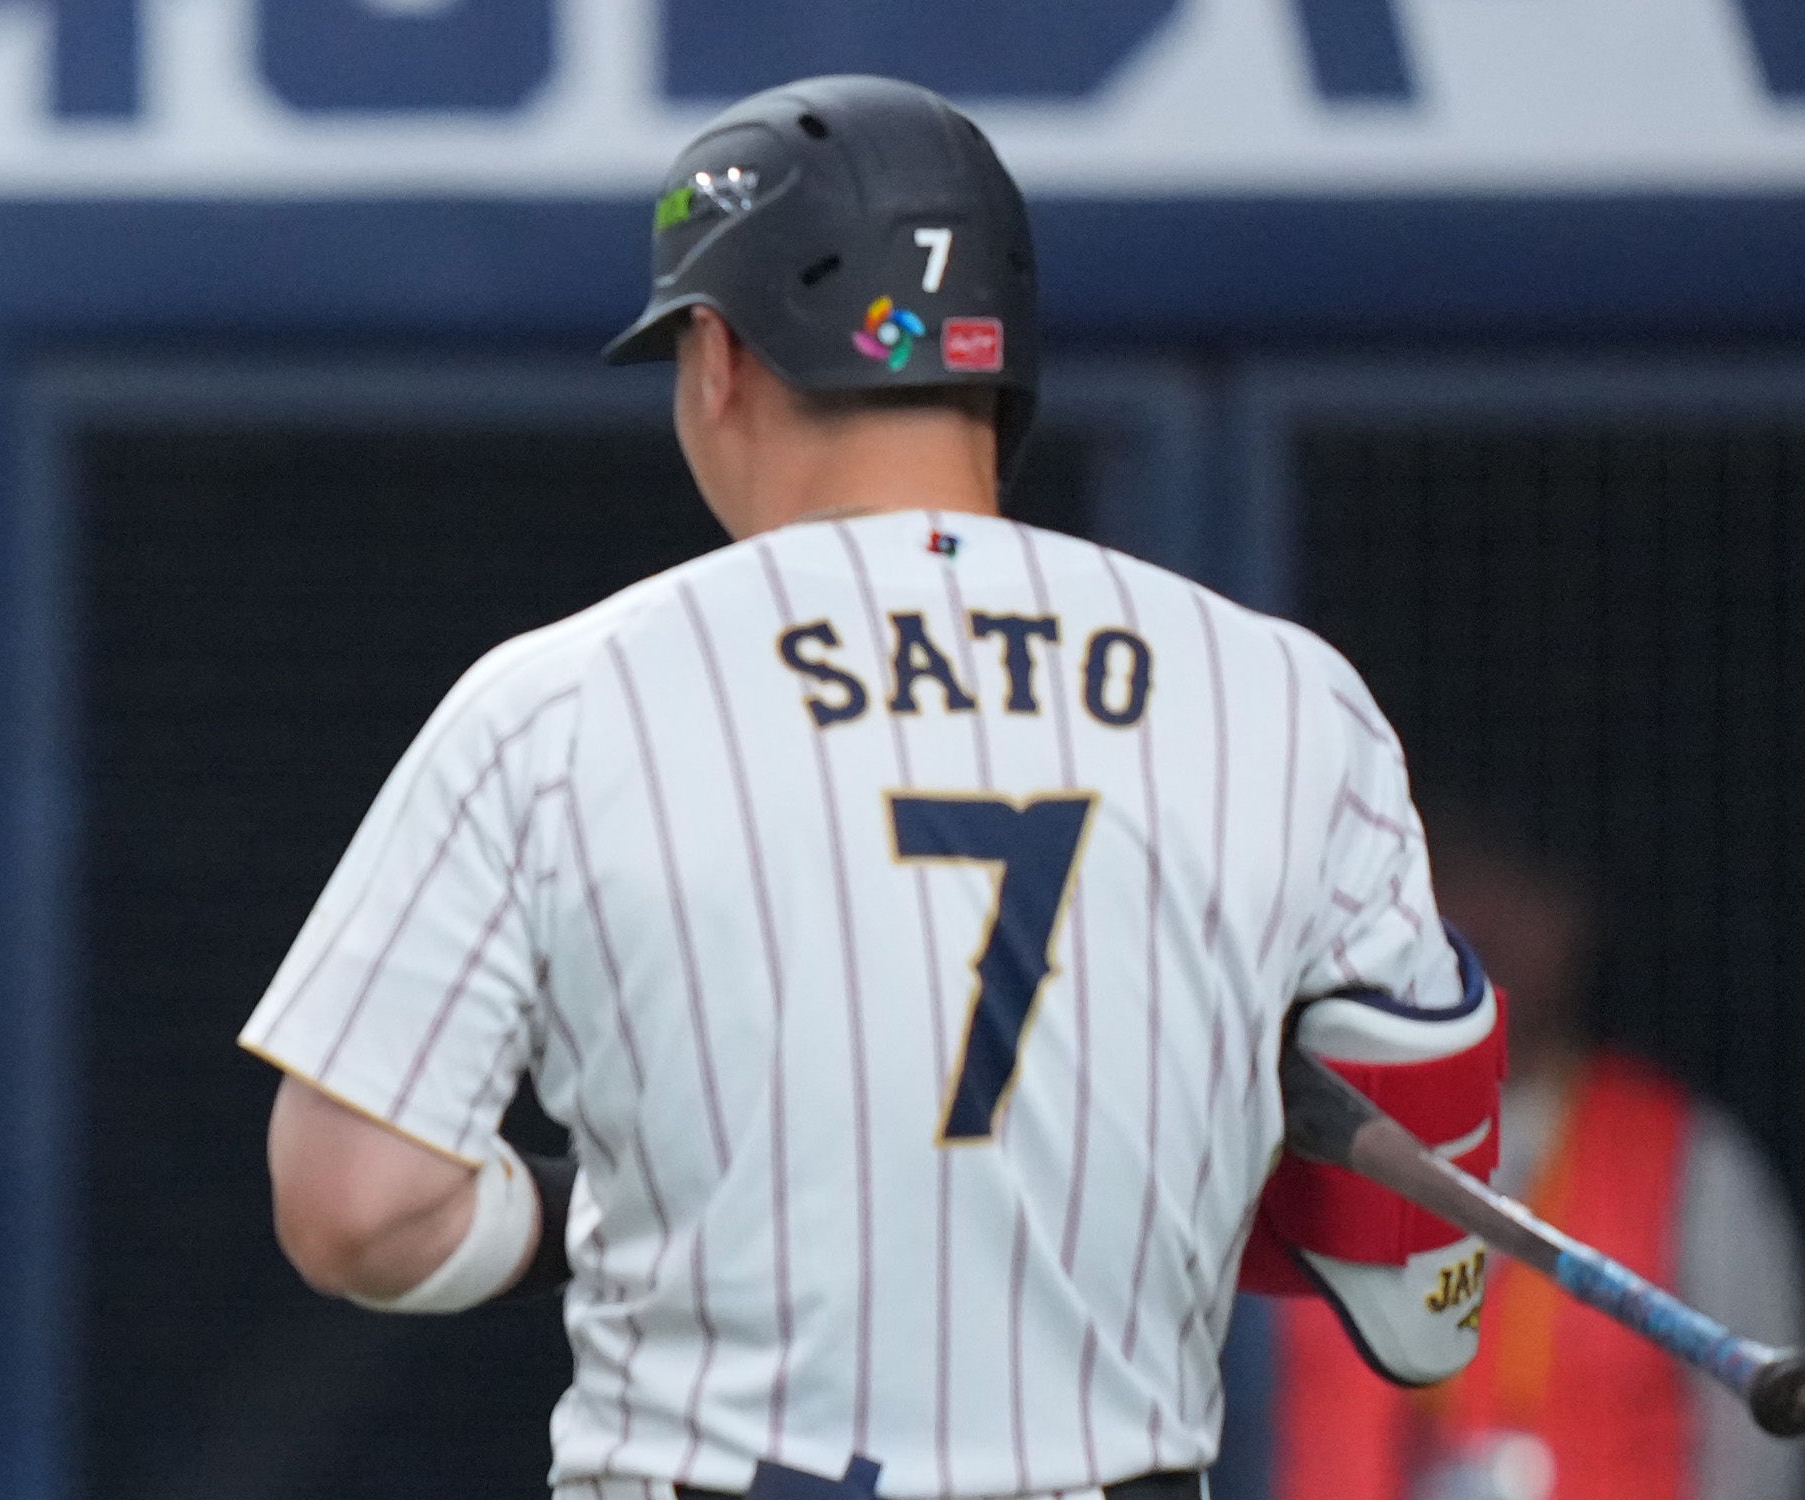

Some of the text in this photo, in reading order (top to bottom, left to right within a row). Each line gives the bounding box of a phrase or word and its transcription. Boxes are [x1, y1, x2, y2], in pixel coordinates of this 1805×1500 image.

[914, 228, 952, 293] 7
[776, 609, 1153, 731] SATO
[881, 789, 1100, 1149] 7
